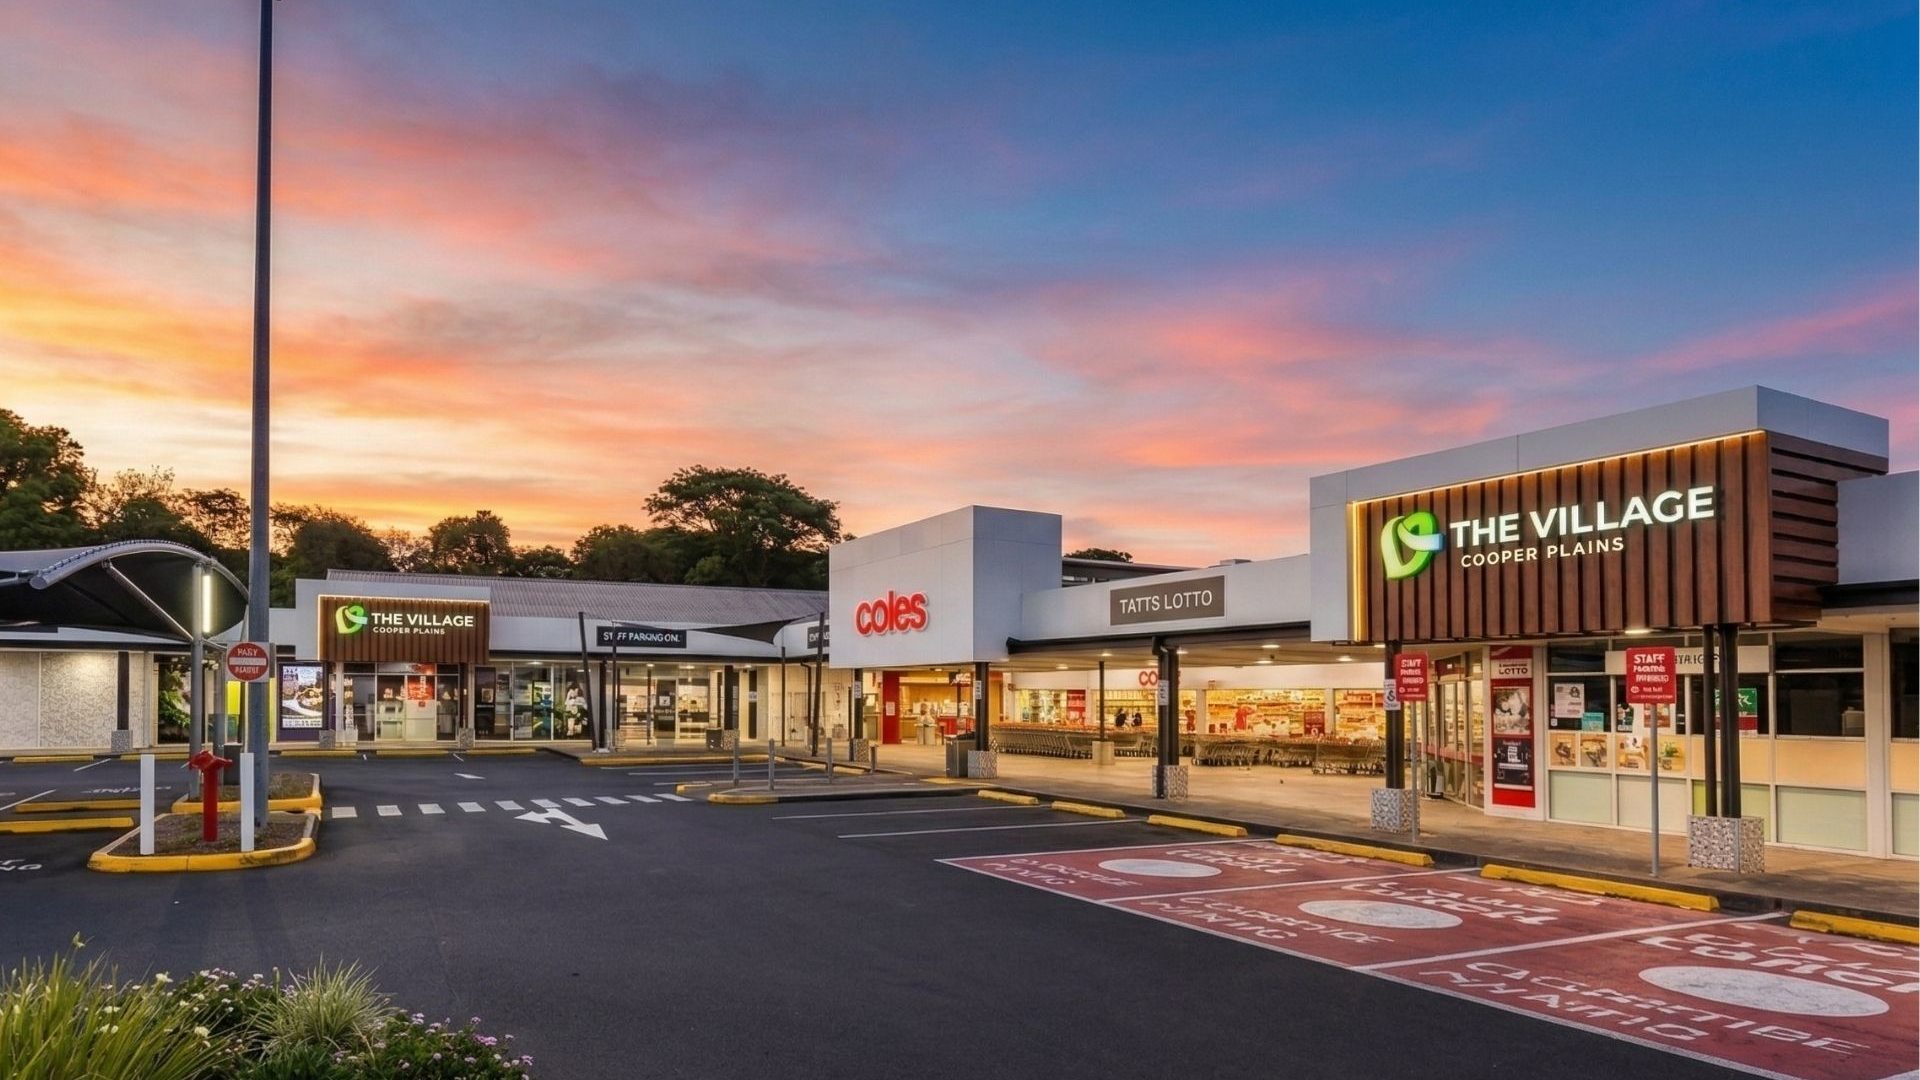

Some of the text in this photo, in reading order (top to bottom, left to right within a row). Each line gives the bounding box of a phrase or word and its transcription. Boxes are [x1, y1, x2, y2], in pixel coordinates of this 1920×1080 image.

[1449, 485, 1715, 549] THE VILLAGE
[1460, 536, 1625, 568] COOPER PLAINS
[1119, 589, 1212, 614] TATTS LOTTO
[371, 612, 474, 627] THE VILLAGE
[855, 589, 928, 636] coles
[373, 626, 445, 635] COOPER PLAINS
[603, 631, 627, 641] STFF
[1633, 653, 1666, 664] STAFF
